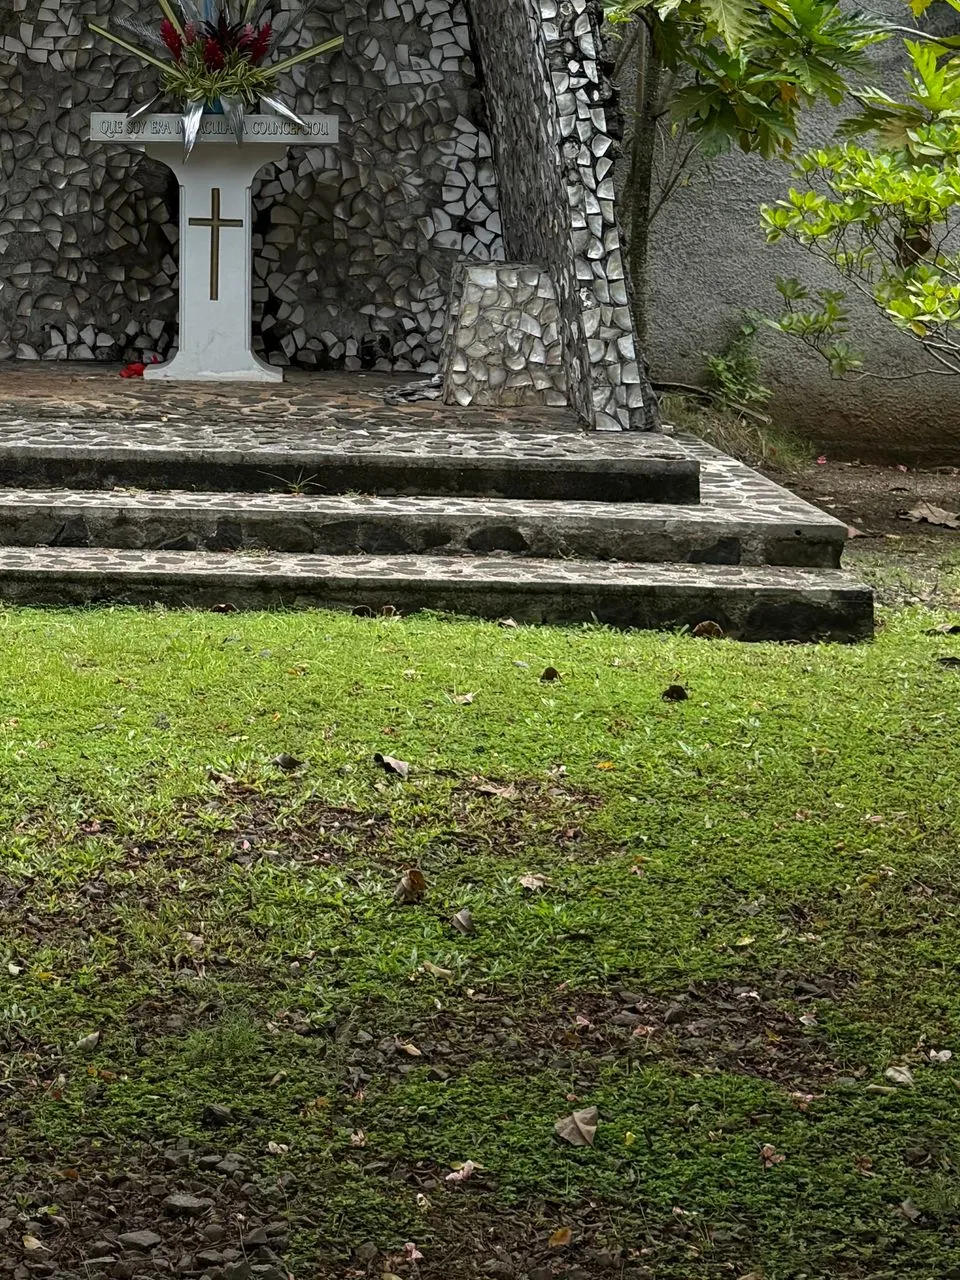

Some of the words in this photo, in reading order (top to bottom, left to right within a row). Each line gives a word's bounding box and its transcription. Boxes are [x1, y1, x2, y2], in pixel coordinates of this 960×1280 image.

[100, 120, 123, 138] QUE
[126, 121, 147, 135] SOY
[151, 121, 171, 135] ERA
